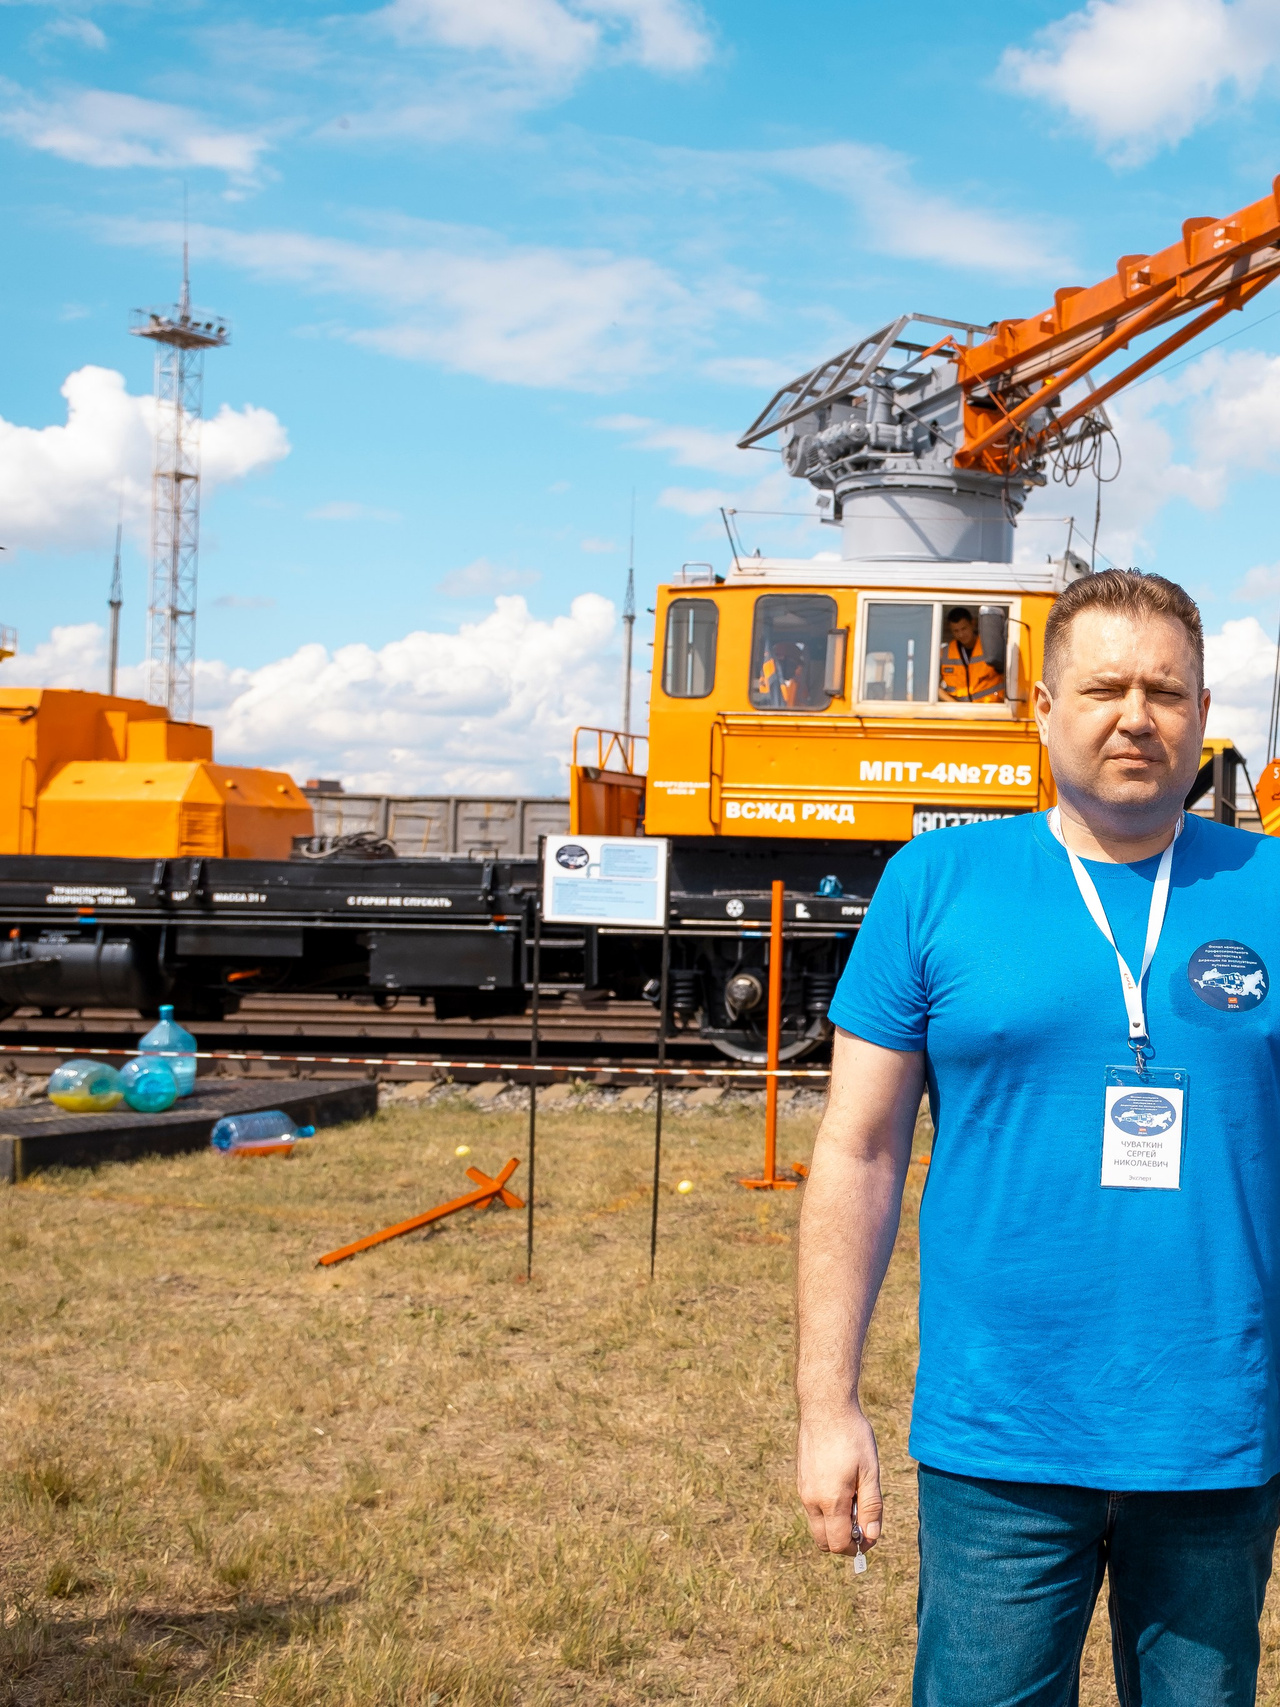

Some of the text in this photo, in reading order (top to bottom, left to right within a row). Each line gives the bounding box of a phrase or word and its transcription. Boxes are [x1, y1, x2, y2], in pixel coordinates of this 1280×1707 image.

[725, 801, 856, 824] ВСЖД РЖД
[347, 895, 452, 907] С ГОРКИ НЕ СПУСКАТЬ
[1121, 1140, 1163, 1149] ЧУВАТКИН
[1126, 1149, 1157, 1158] СЕРГЕЙ
[1113, 1158, 1169, 1168] НИКОЛАЕВИЧ
[1128, 1174, 1152, 1182] Эксперт
